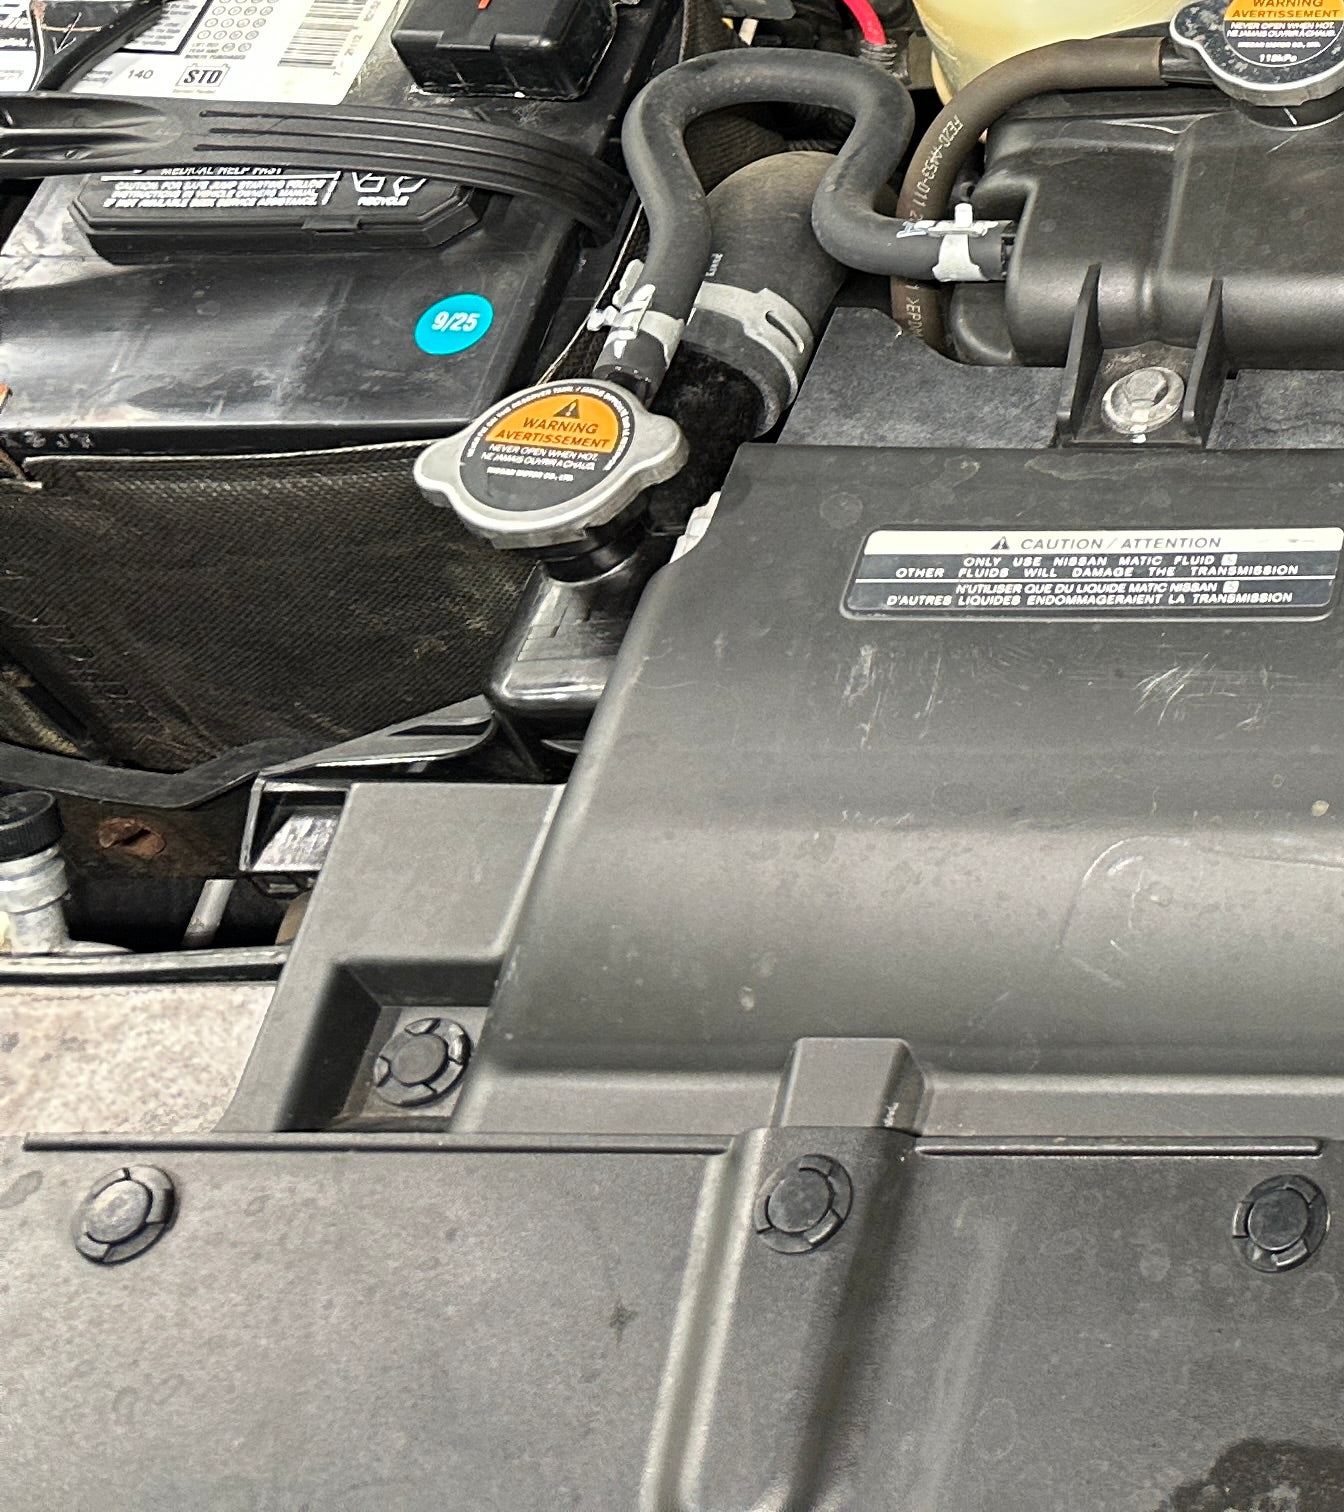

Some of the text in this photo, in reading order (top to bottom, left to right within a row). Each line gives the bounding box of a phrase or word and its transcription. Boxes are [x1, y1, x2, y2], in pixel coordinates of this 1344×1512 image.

[1231, 9, 1340, 19] AVERTISSEMENT
[1230, 21, 1260, 30] NEVER
[1260, 22, 1286, 30] OPEN
[1287, 22, 1315, 30] WHEN
[127, 69, 154, 80] 140
[431, 310, 481, 333] 9/25
[523, 416, 599, 435] WARNING
[495, 429, 612, 449] AVERTISSEMENT
[488, 443, 521, 454] NEVER
[520, 446, 547, 458] OPEN
[547, 448, 576, 461] WHEN
[1020, 538, 1103, 551] CAUTION
[1120, 536, 1222, 551] ATTENTION
[963, 556, 1001, 567] ONLY
[1012, 556, 1042, 567] USE
[1053, 556, 1108, 567] NISSAN
[1117, 555, 1163, 566] MATIC
[1173, 555, 1215, 566] FLUID
[895, 565, 1299, 578] OTHER FLUIDS WILL DAMAGE THE TRANSMISSION
[955, 583, 1022, 595] N'UTILISER
[1023, 583, 1054, 595] QUE
[1054, 583, 1074, 594] DU
[1075, 583, 1126, 594] LIQUIDE
[1128, 582, 1168, 594] MATIC
[1169, 582, 1218, 593] NISSAN
[886, 592, 1293, 606] D'AUTRES LIQUIDES ENDOMMAGERAIENT LA TRANSMISSION
